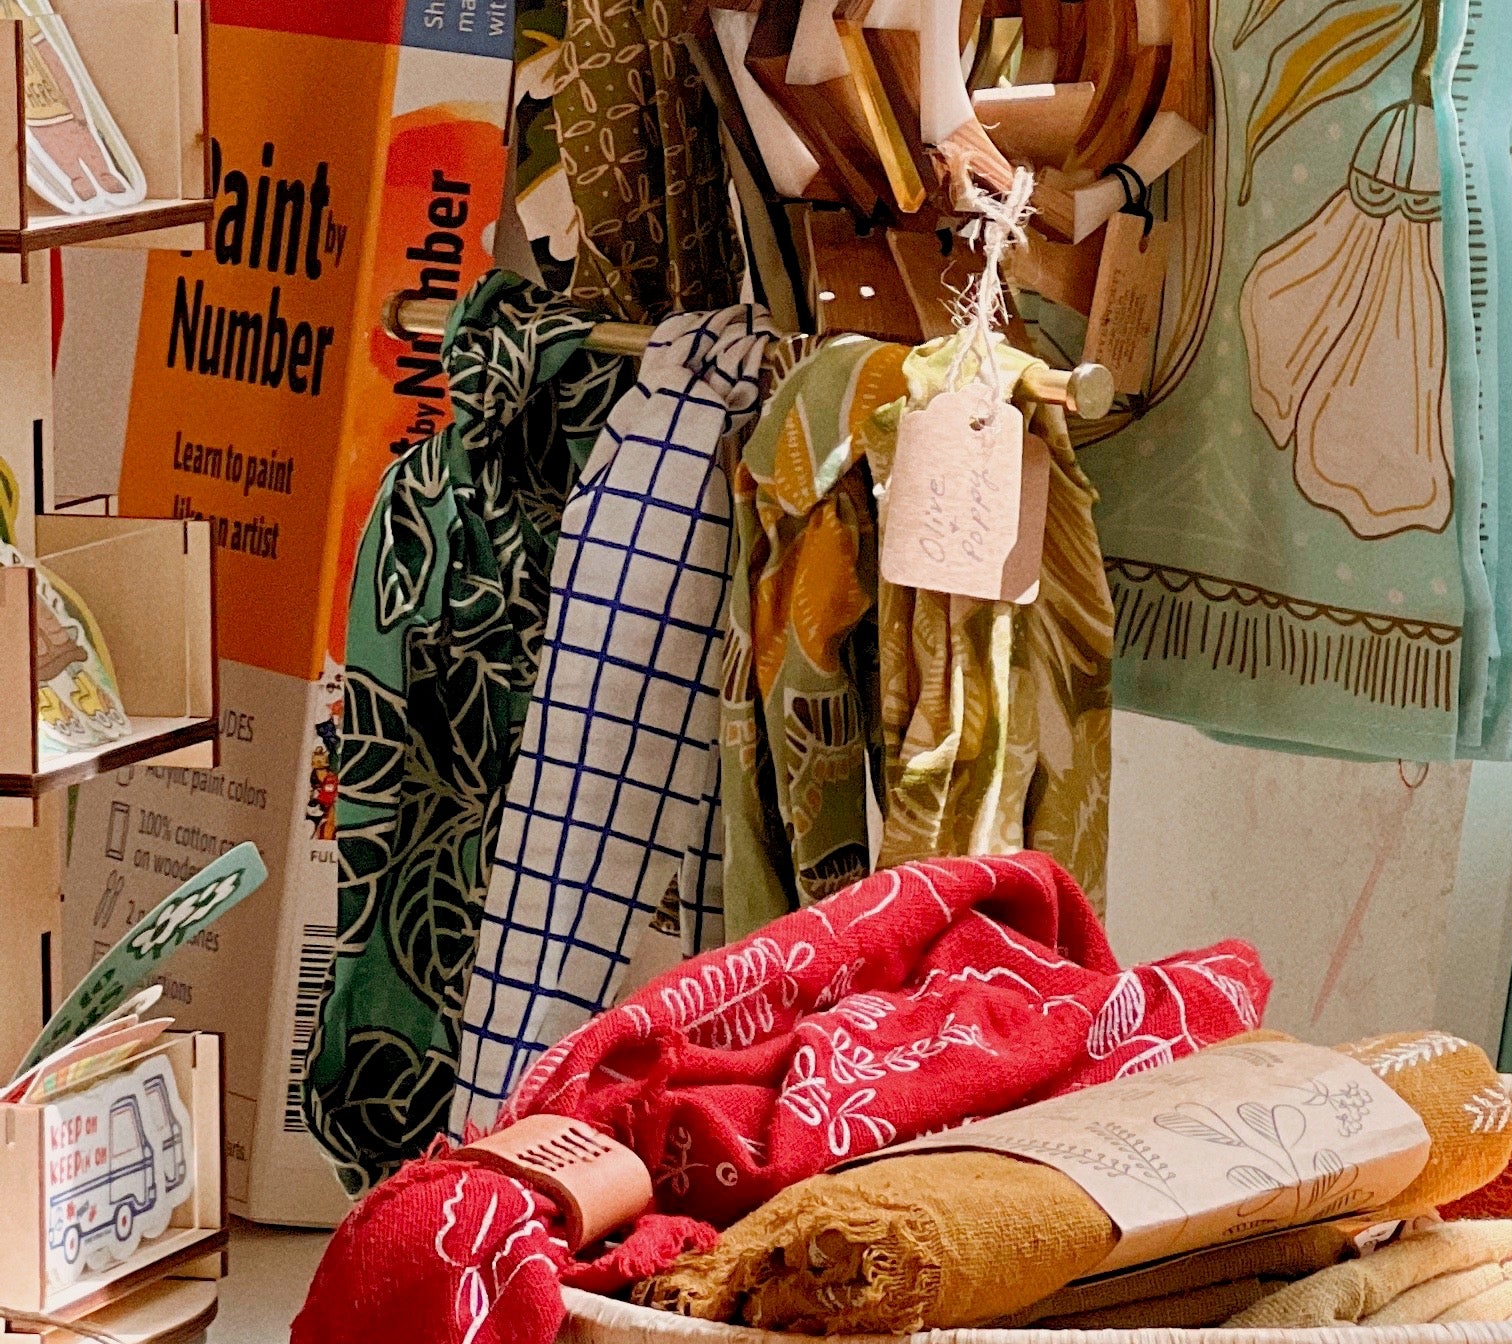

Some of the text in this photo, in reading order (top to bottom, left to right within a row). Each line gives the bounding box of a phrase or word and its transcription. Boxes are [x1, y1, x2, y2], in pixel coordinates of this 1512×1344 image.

[324, 210, 347, 269] by
[390, 169, 472, 400] Nmber
[166, 274, 334, 397] Number
[172, 430, 295, 496] Learn to paint
[230, 520, 280, 560] artist
[918, 474, 947, 565] Olive
[961, 467, 1001, 562] Poppy
[191, 769, 227, 800] paint
[228, 780, 266, 809] colors
[138, 809, 171, 840] 100%
[174, 824, 218, 852] cotton
[152, 855, 199, 881] woode
[311, 850, 337, 864] FUL
[51, 1116, 82, 1149] KEEP
